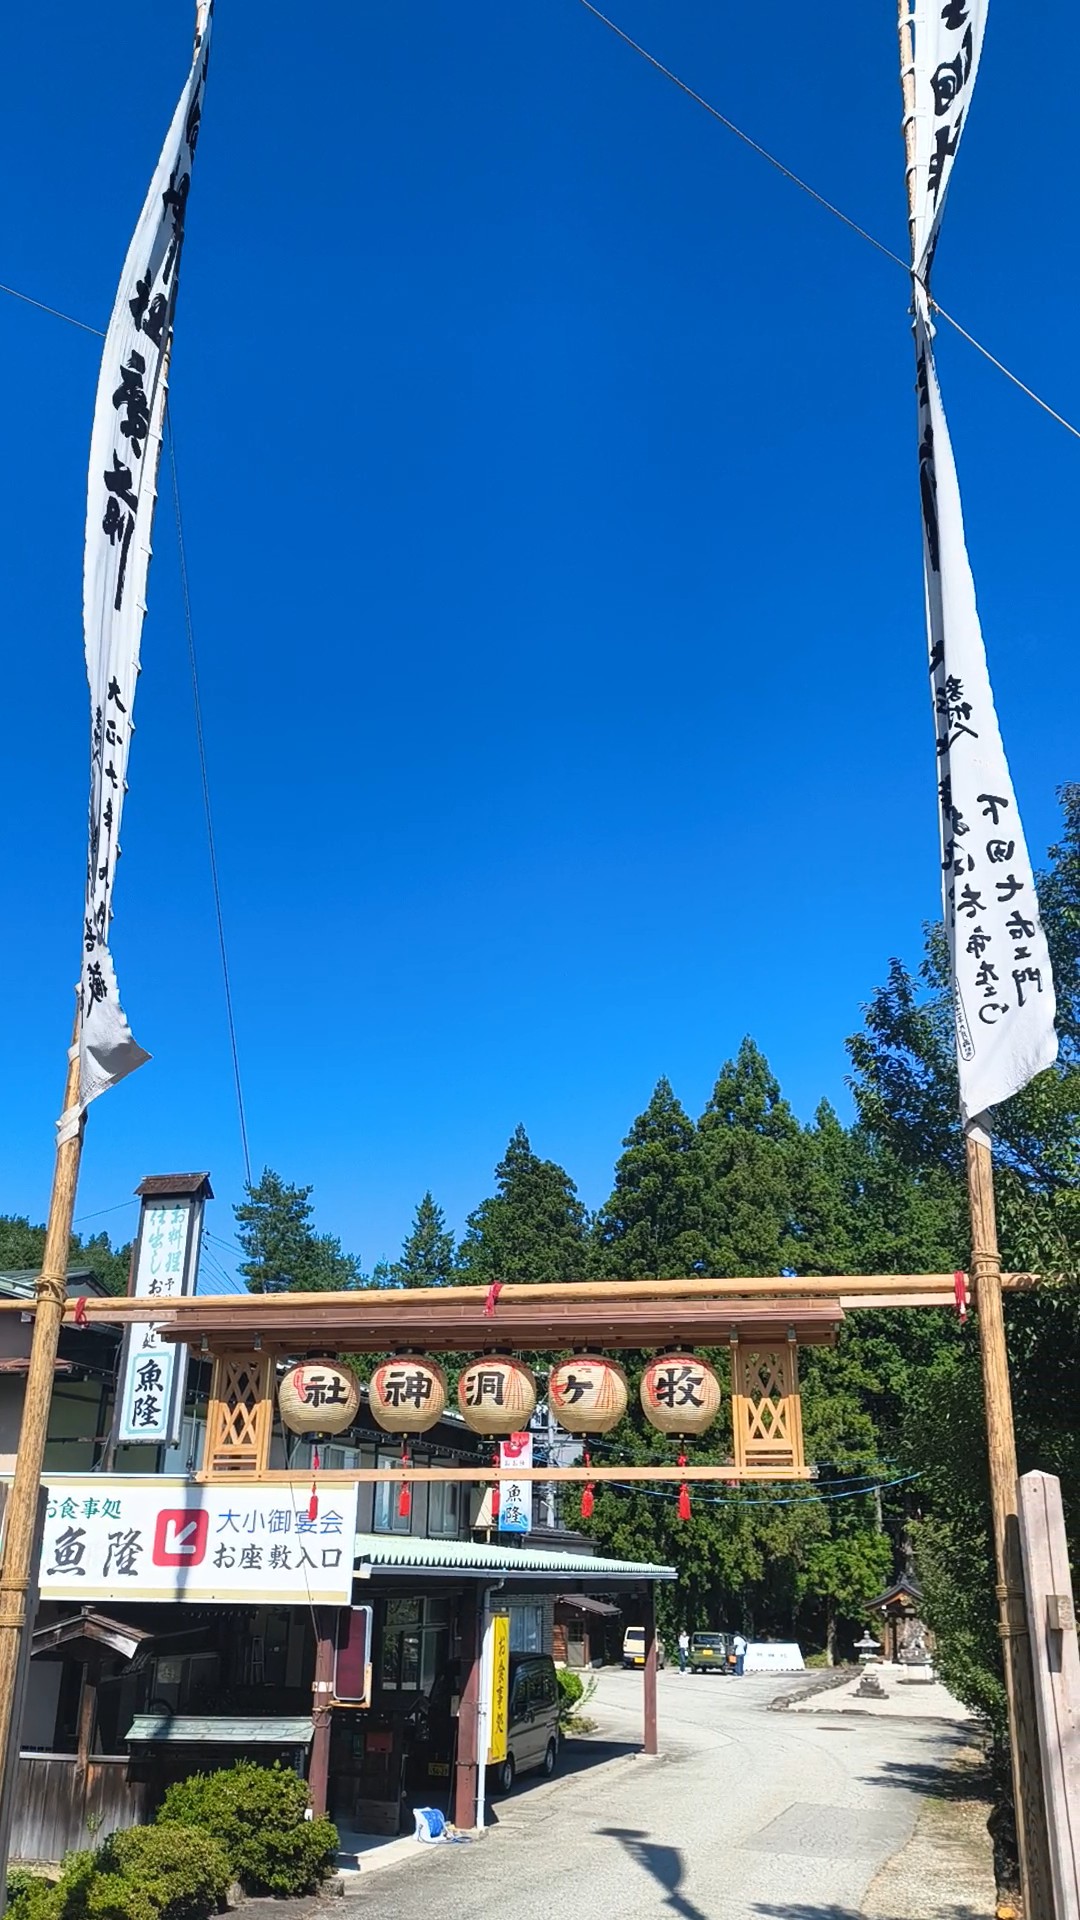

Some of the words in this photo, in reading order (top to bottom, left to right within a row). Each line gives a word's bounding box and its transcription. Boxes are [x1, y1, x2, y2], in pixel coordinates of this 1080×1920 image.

[165, 1204, 186, 1273] お料理
[132, 1359, 164, 1427] 魚隆
[303, 1375, 348, 1408] 社
[385, 1371, 433, 1409] 神
[466, 1371, 504, 1406] 洞
[656, 1366, 705, 1408] 牧
[215, 1509, 344, 1535] 大小御宴会
[505, 1484, 522, 1524] 魚隆
[46, 1525, 144, 1577] 魚隆
[213, 1546, 342, 1571] お座敷入口
